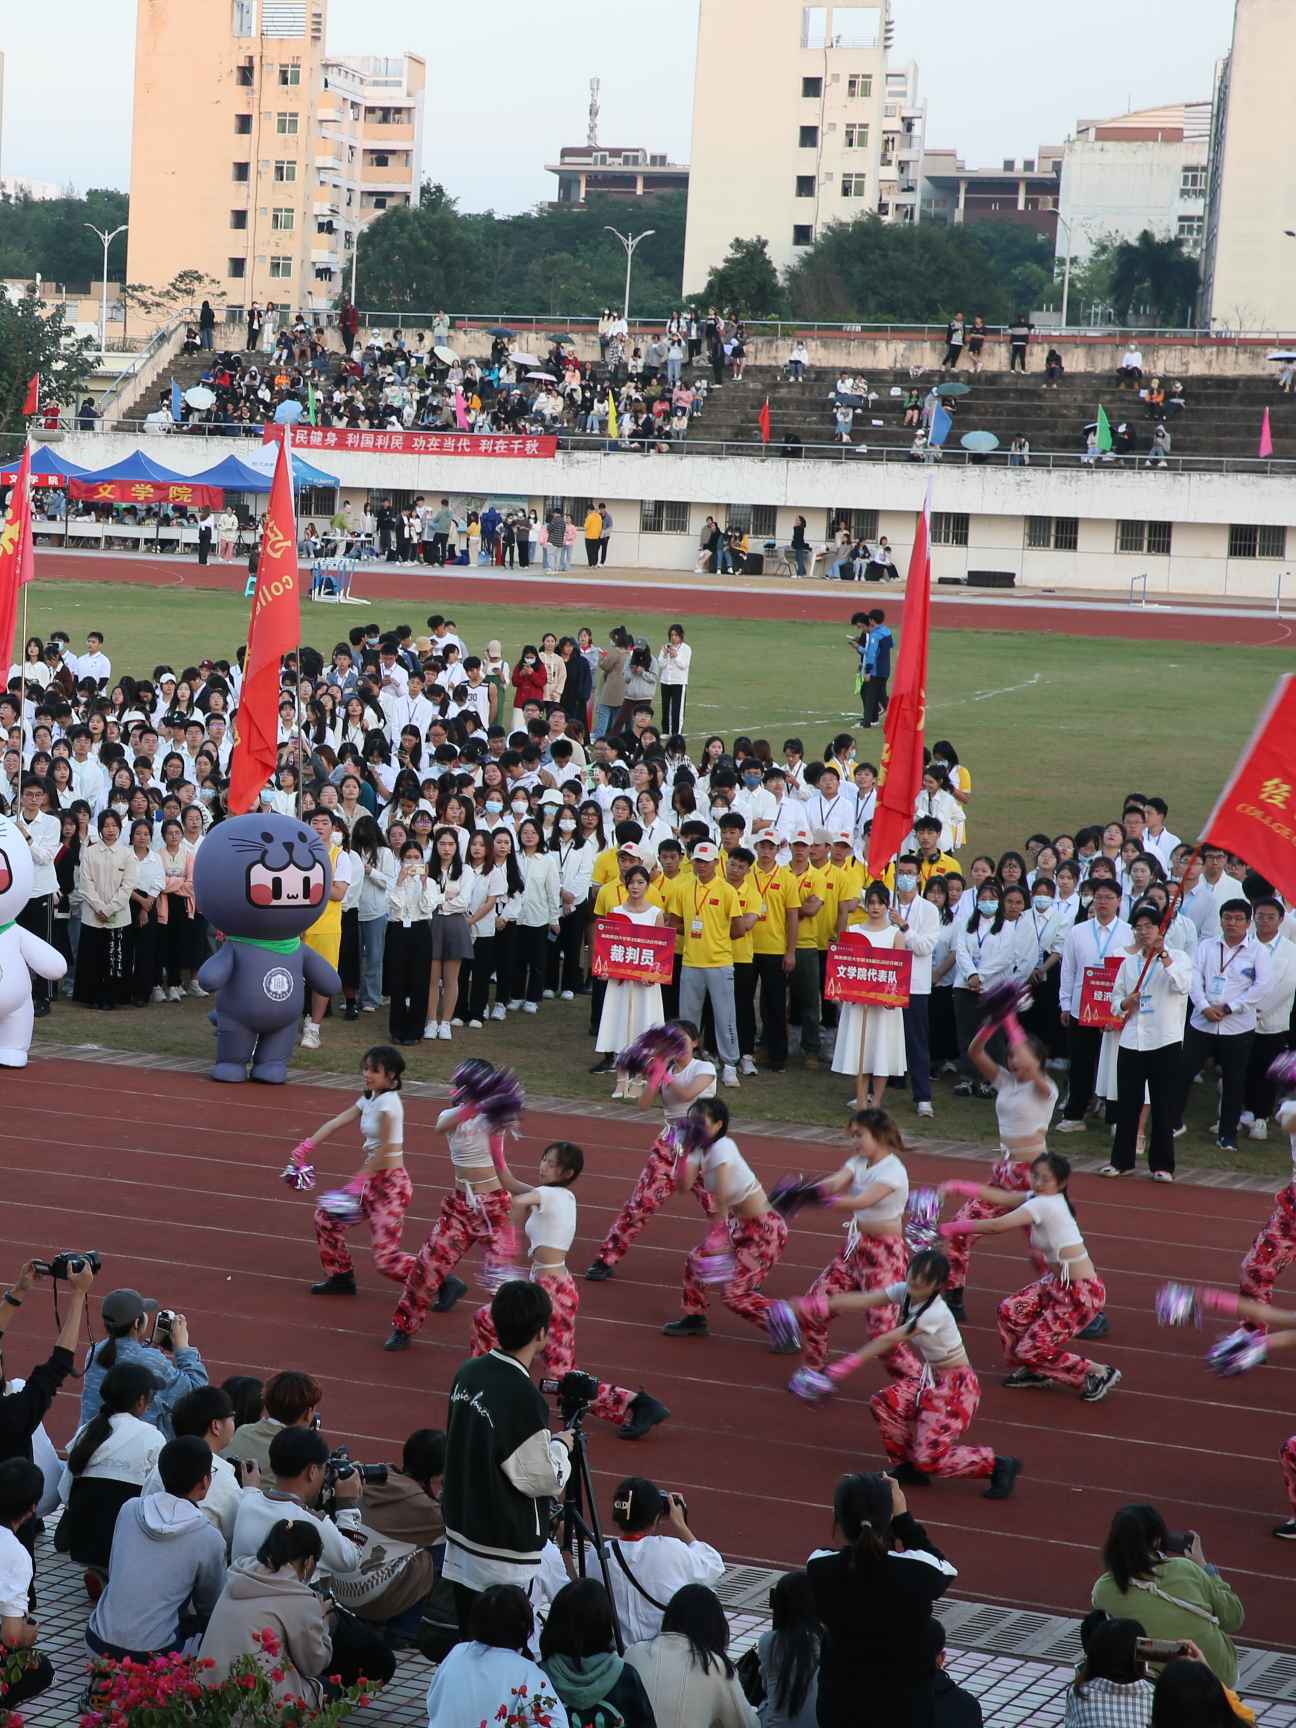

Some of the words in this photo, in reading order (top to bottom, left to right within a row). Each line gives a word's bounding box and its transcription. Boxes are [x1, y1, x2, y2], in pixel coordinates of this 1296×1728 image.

[290, 431, 337, 446] 民健身
[345, 434, 404, 450] 利国利民
[411, 436, 471, 452] 功在当代
[479, 438, 540, 455] 利在千秋
[93, 484, 193, 502] 文学院
[610, 943, 655, 967] 裁判员
[836, 964, 898, 985] 文学院代表队
